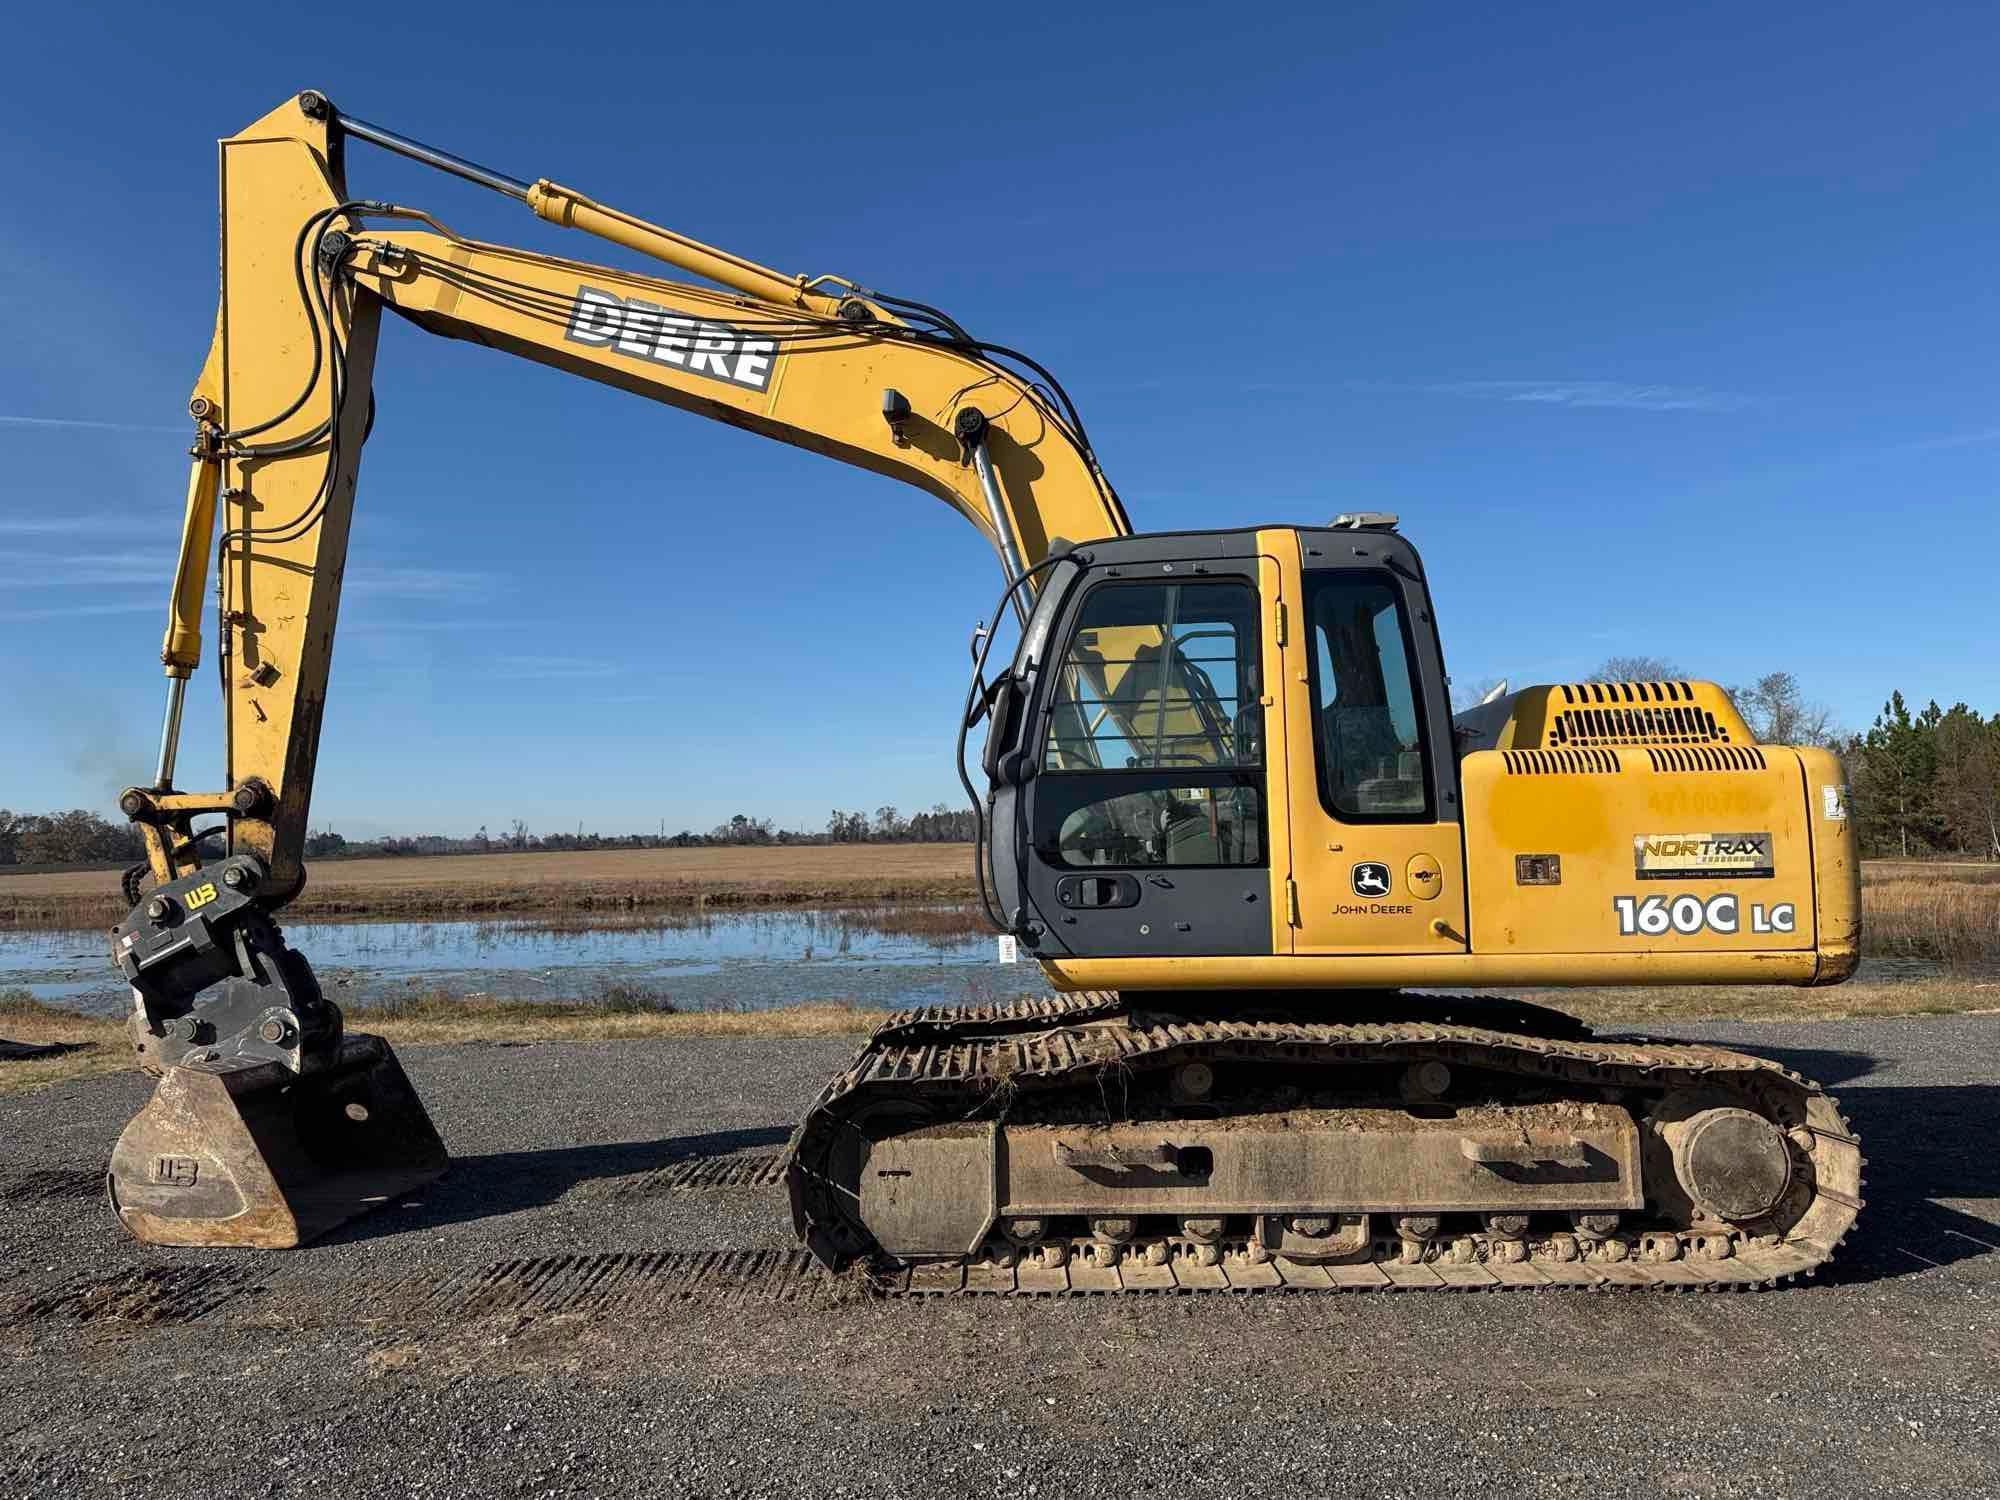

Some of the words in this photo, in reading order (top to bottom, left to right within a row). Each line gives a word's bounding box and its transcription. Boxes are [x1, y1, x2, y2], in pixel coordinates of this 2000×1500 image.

[569, 289, 776, 388] DEERE
[1642, 839, 1766, 857] NORTRAX
[1331, 903, 1368, 915] JOHN
[1370, 903, 1413, 915] DEERE
[1615, 895, 1738, 934] 160C
[1752, 904, 1794, 933] LC
